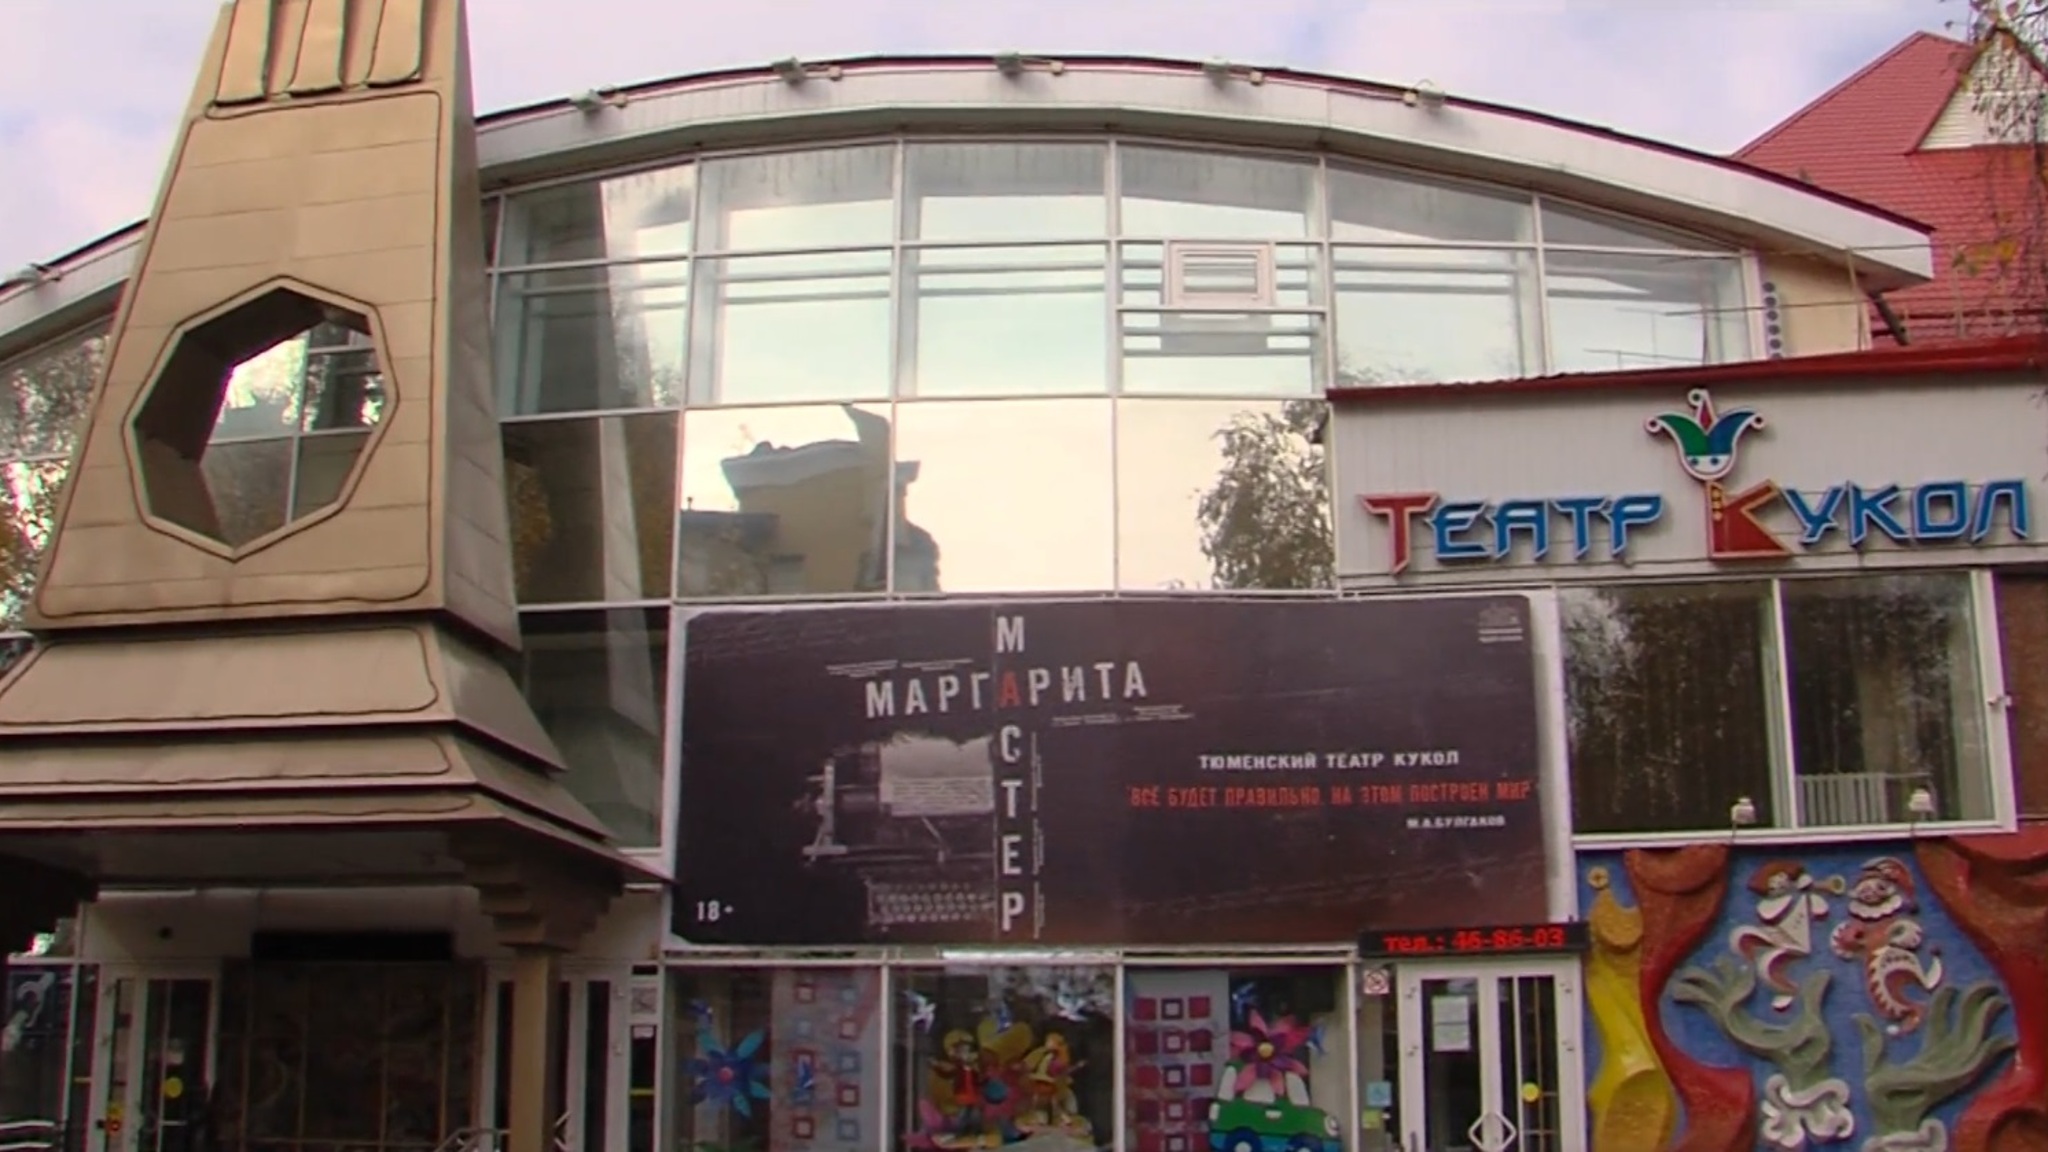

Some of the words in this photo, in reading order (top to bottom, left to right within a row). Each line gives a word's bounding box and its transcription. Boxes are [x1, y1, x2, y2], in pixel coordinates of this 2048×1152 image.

[865, 660, 1148, 719] МАРГАРИТА
[1198, 752, 1316, 770] ТЮМЕНСКИЙ
[1326, 752, 1384, 769] ТЕАТР
[1393, 750, 1460, 767] КУКОЛ
[1168, 786, 1217, 807] БУДЕТ
[1331, 785, 1352, 804] НА
[1359, 783, 1403, 805] ЭТОМ
[1410, 781, 1489, 803] ПОСТРОЕН
[697, 900, 734, 921] 18+
[1452, 927, 1565, 951] 46-86-03
